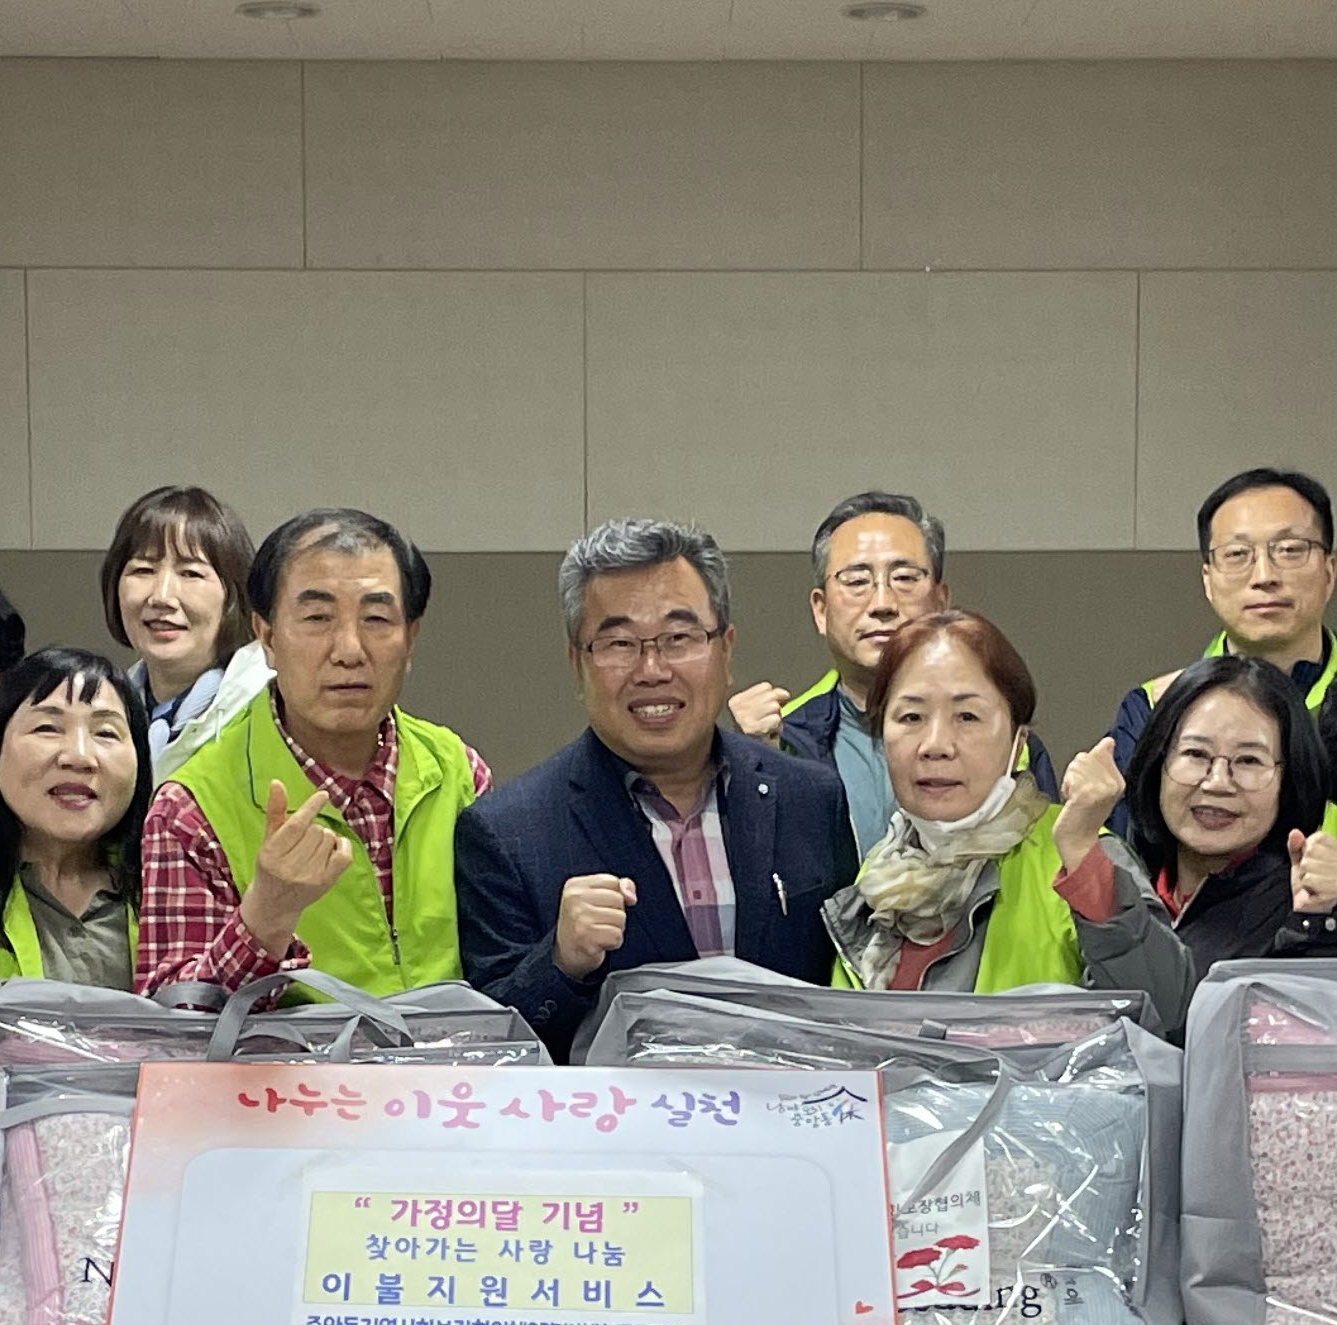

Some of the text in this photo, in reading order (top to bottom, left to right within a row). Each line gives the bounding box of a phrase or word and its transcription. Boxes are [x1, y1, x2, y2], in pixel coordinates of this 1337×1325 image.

[238, 1083, 367, 1120] 나누는
[384, 1082, 487, 1129] 이웃
[500, 1086, 638, 1133] 사랑
[651, 1090, 741, 1127] 실천
[391, 1198, 524, 1233] 가정의달
[542, 1202, 605, 1234] 기념
[366, 1234, 626, 1268] 찾아가는 사랑 나눔
